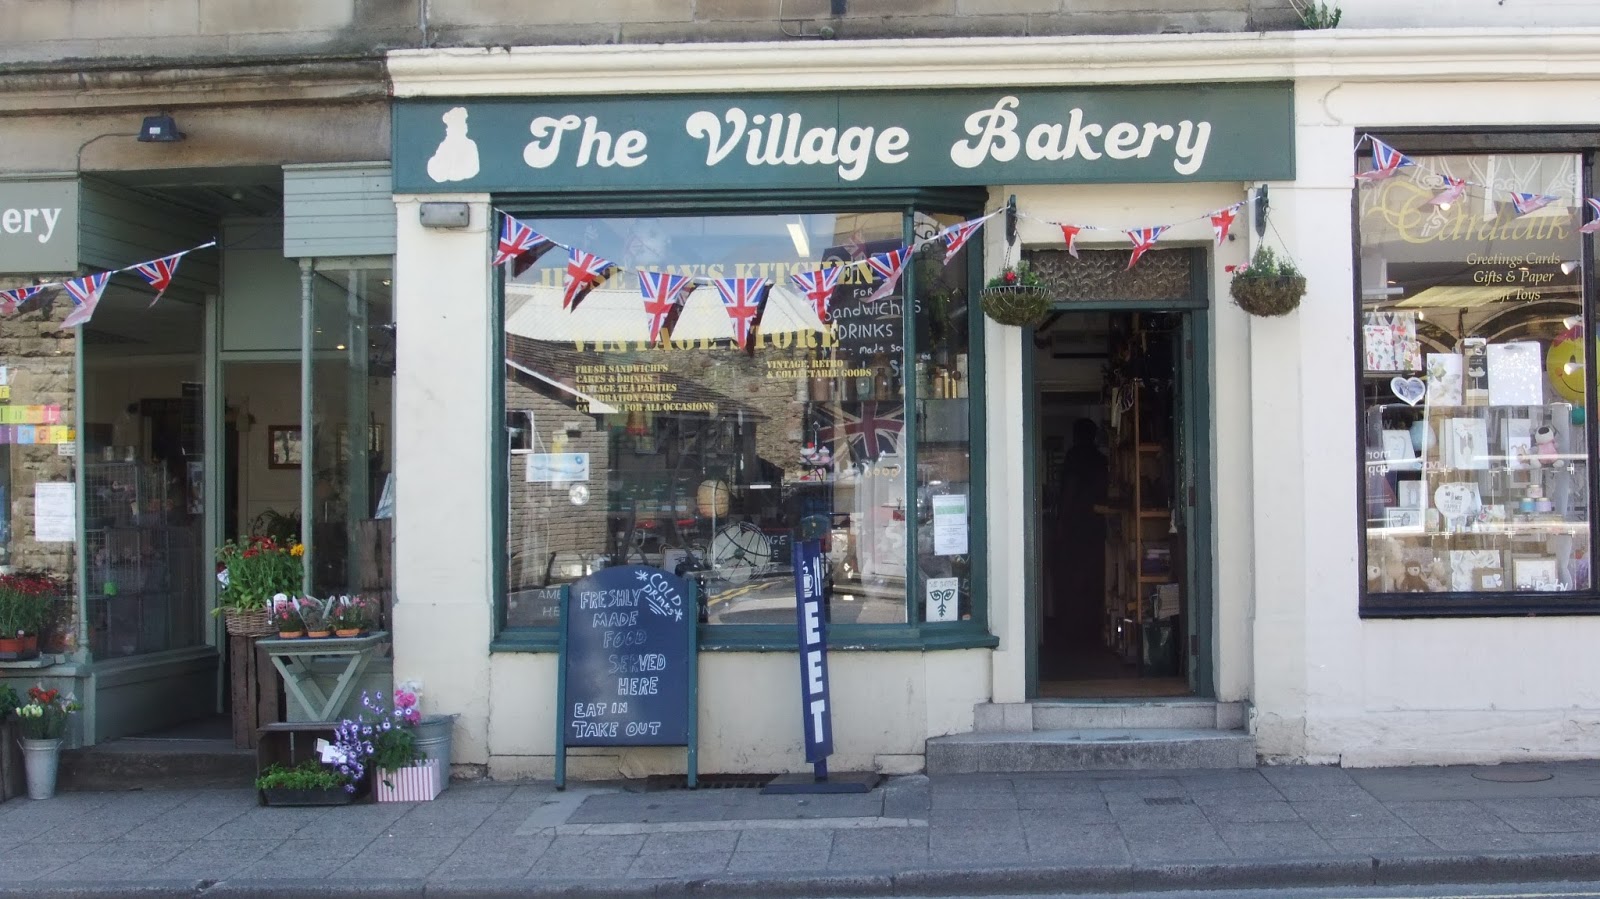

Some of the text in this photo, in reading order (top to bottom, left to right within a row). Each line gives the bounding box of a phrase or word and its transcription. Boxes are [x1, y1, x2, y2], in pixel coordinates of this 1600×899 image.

[523, 95, 1212, 181] The Village Bakery
[1466, 252, 1560, 268] Greetings Cards
[1473, 270, 1555, 286] Gifts & Paper
[853, 288, 873, 298] FOR
[1515, 288, 1541, 303] Toys
[729, 323, 839, 349] TORE
[838, 323, 894, 340] DRINKS
[575, 364, 606, 374] FRESH
[812, 359, 844, 368] RETRO
[576, 374, 653, 383] CAKES & DRINKS
[766, 368, 872, 379] & COLLECTABLE GOODS
[576, 383, 677, 393] VINTAGE TEA PARTIES
[576, 393, 640, 403] CEBRATION
[624, 402, 643, 412] FOR
[645, 402, 662, 412] ALL
[663, 401, 715, 411] OCCASIONS
[650, 573, 682, 606] COLD
[580, 588, 641, 610] FRESHLY
[592, 610, 639, 629] MADE
[603, 629, 647, 648] FOOD
[608, 653, 666, 674] SERVED
[617, 676, 659, 696] HERE
[573, 702, 628, 718] EAT IN
[571, 720, 661, 739] TAKE OUT
